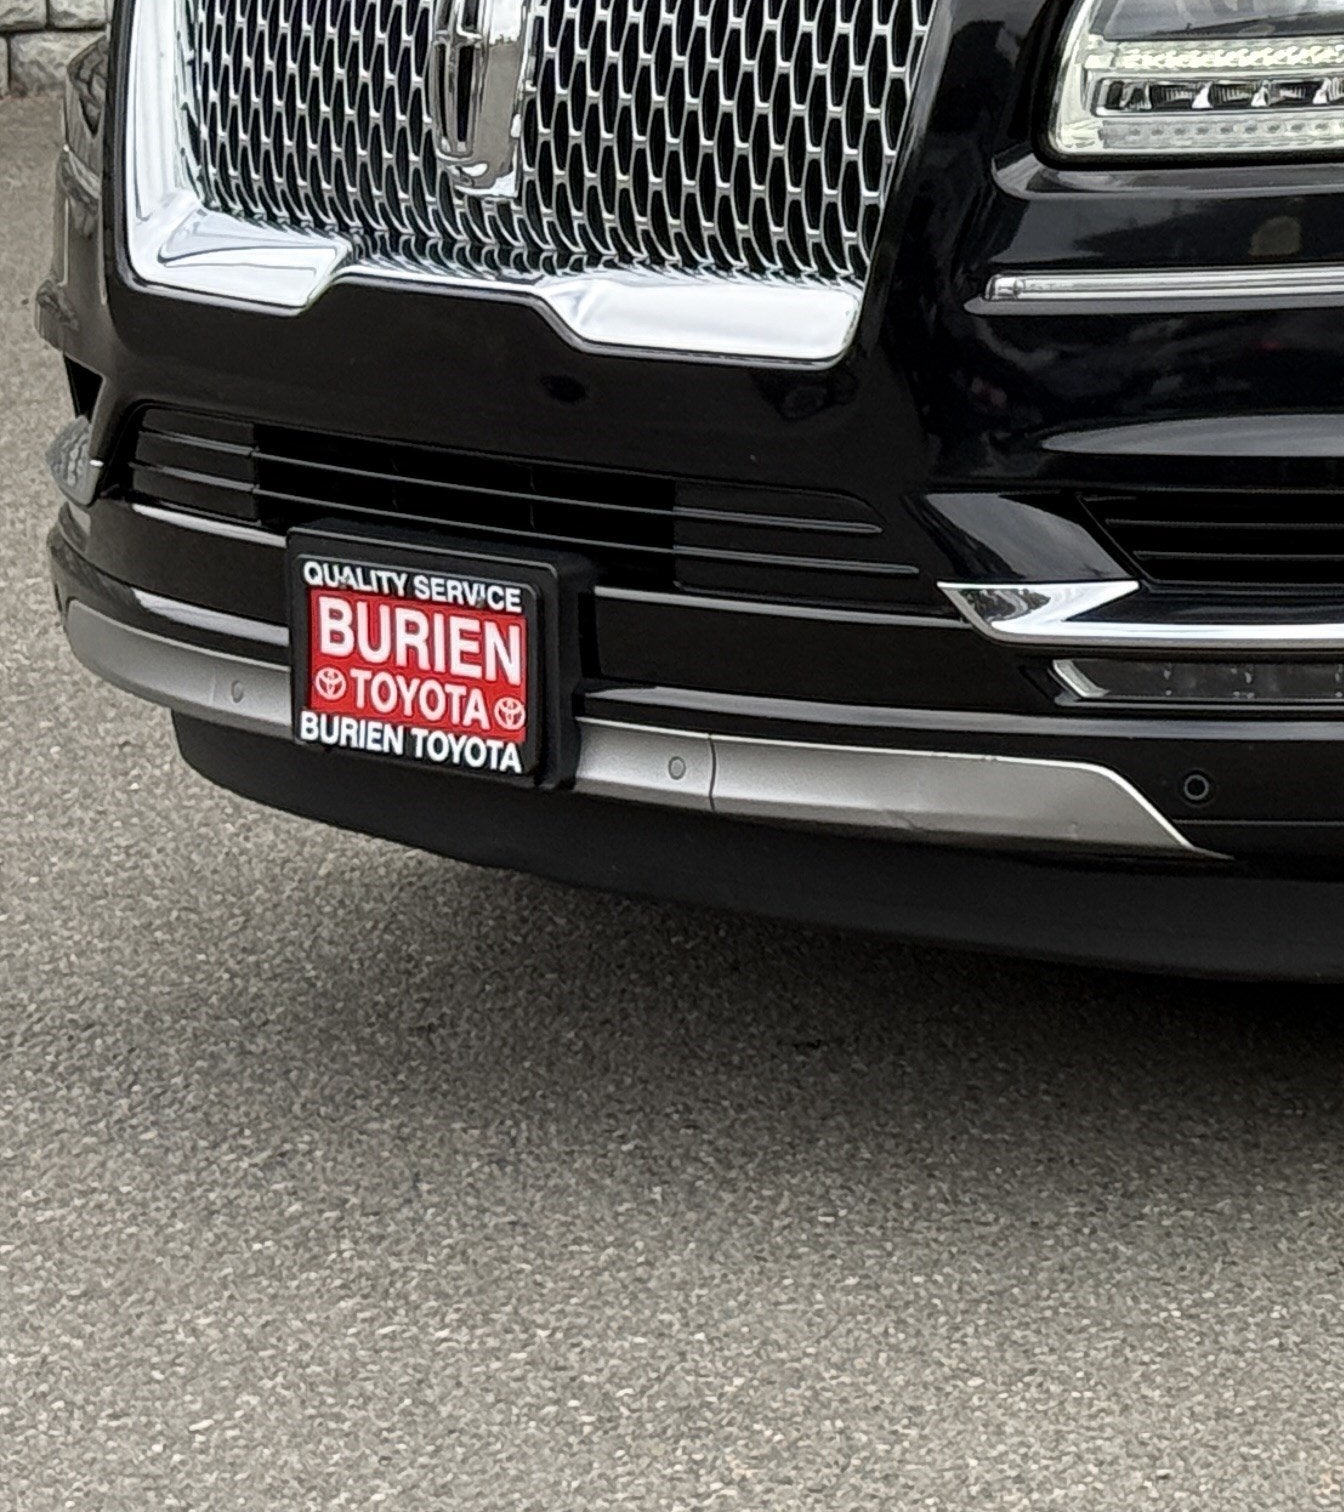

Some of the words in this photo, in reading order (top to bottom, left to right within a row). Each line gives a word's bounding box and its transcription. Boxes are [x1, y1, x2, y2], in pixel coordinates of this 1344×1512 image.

[303, 560, 408, 597] QUALITY
[413, 574, 523, 613] SERVICE
[318, 595, 522, 686] BURIEN
[349, 667, 491, 730] TOYOTA
[300, 710, 404, 756] BURIEN
[410, 727, 523, 774] TOYOTA
